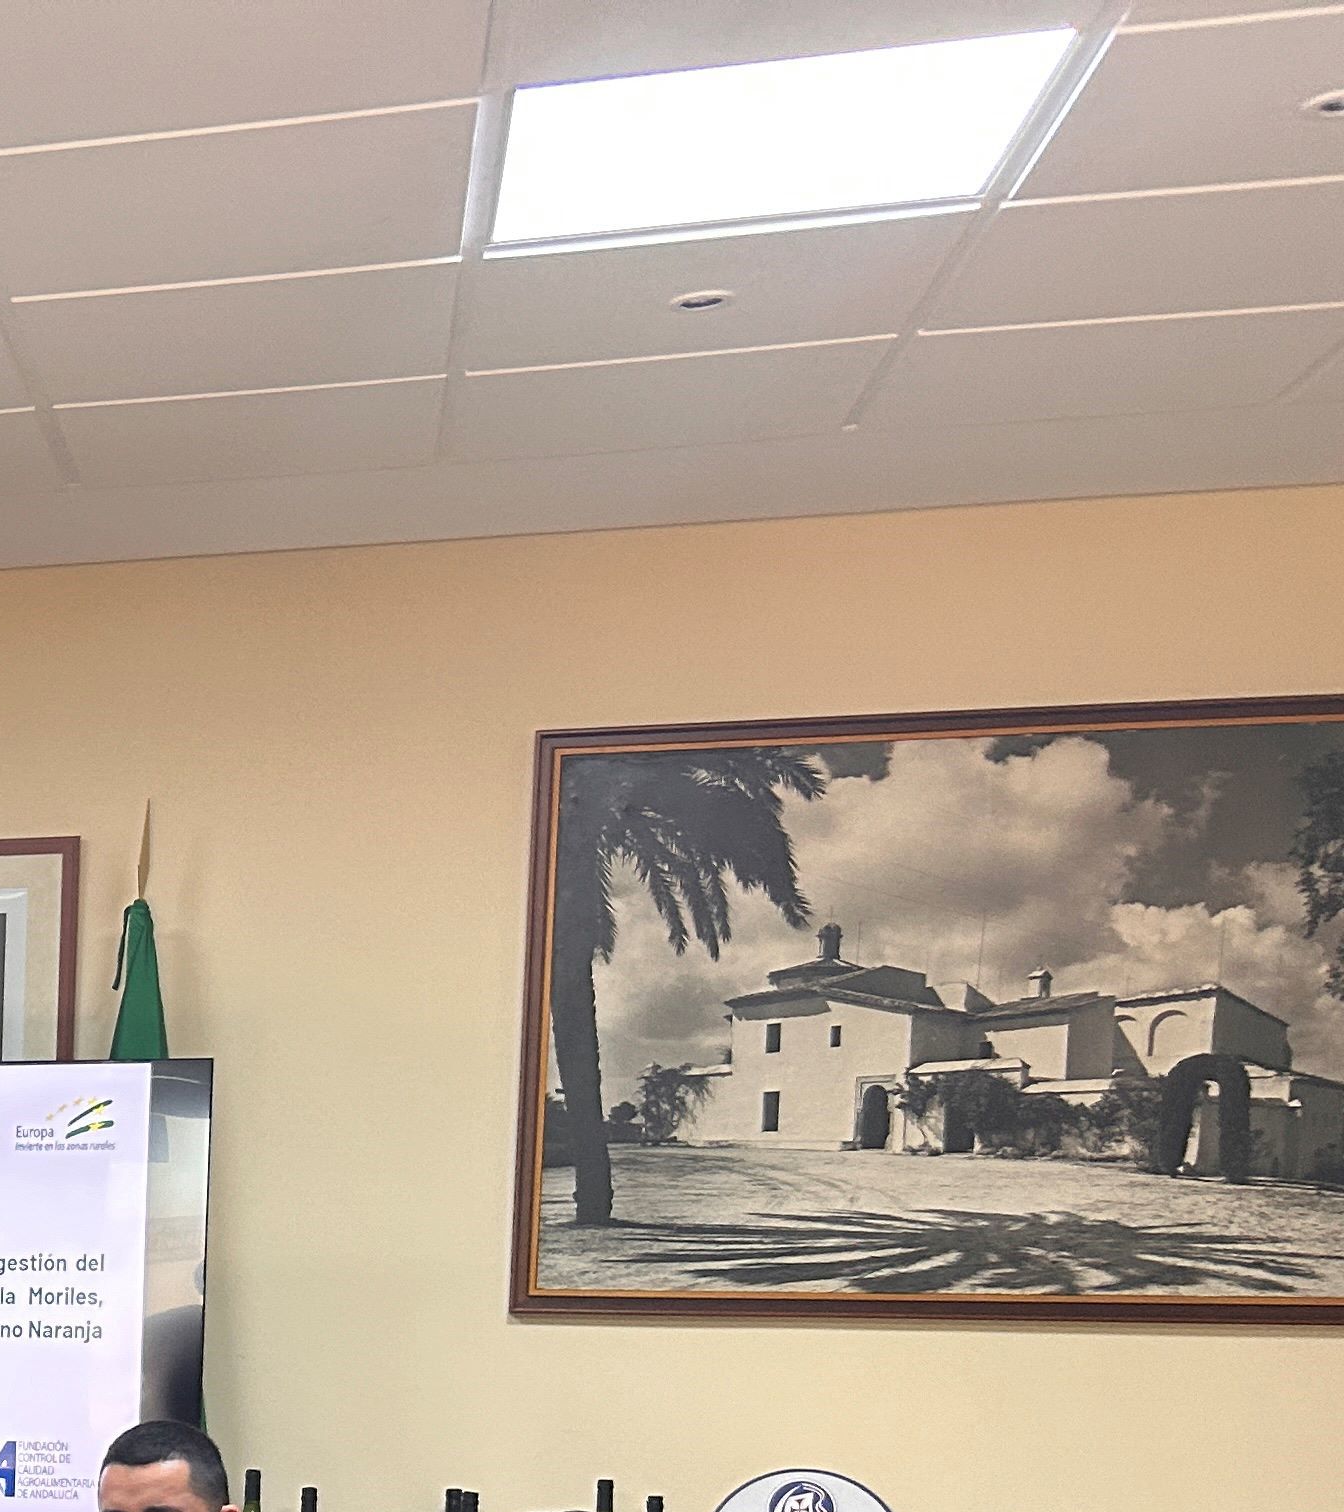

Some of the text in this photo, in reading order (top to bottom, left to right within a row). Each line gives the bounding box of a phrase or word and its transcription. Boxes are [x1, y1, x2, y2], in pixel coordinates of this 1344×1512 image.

[16, 1126, 54, 1140] Europa
[76, 1254, 105, 1272] del
[28, 1287, 103, 1307] Moriles,
[28, 1320, 102, 1343] Naranja
[18, 1440, 69, 1452] FUNDACIÓN
[18, 1453, 71, 1464] CONTROL DE
[18, 1464, 55, 1475] CALIDAD
